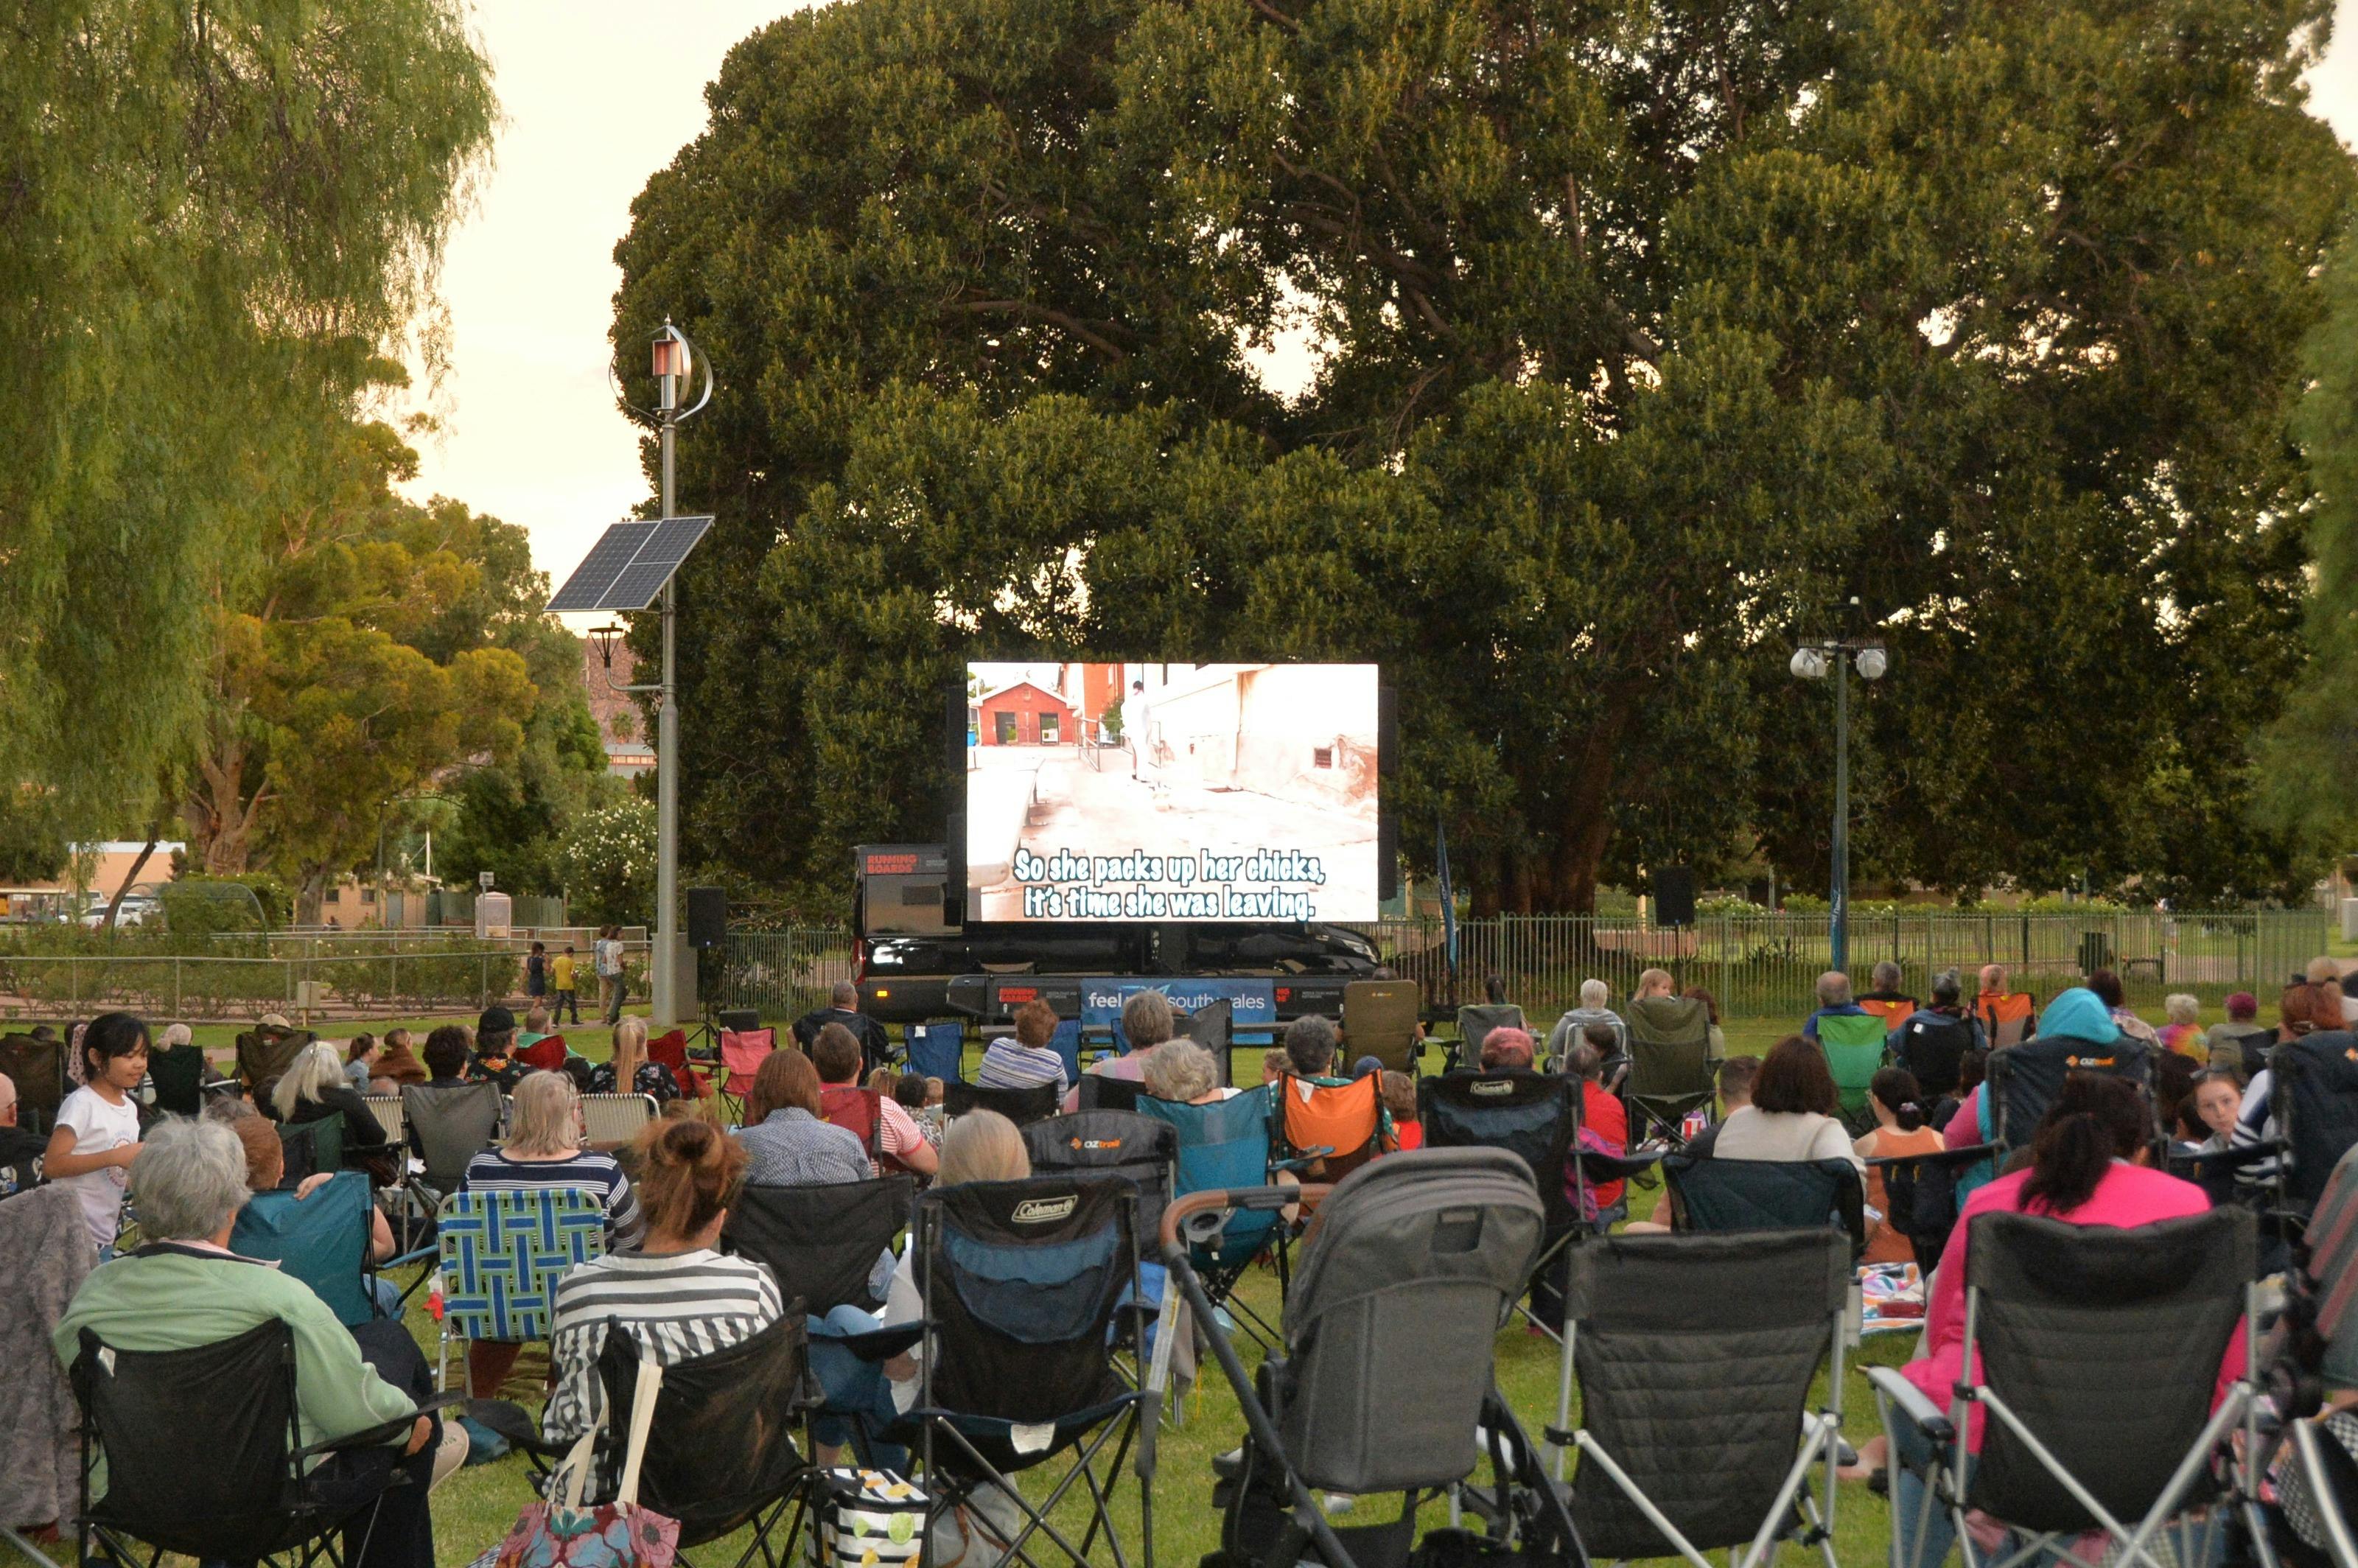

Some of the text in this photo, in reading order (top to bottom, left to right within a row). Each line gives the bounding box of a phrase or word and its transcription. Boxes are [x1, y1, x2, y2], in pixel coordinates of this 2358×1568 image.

[1014, 848, 1326, 887] So she packs up her chicks,
[1066, 886, 1121, 917] time
[1124, 883, 1165, 917] she
[1169, 892, 1219, 918] was
[1222, 884, 1315, 922] leaving.
[1088, 992, 1122, 1008] feel
[1217, 993, 1265, 1009] ales
[1020, 1203, 1064, 1217] Coleman
